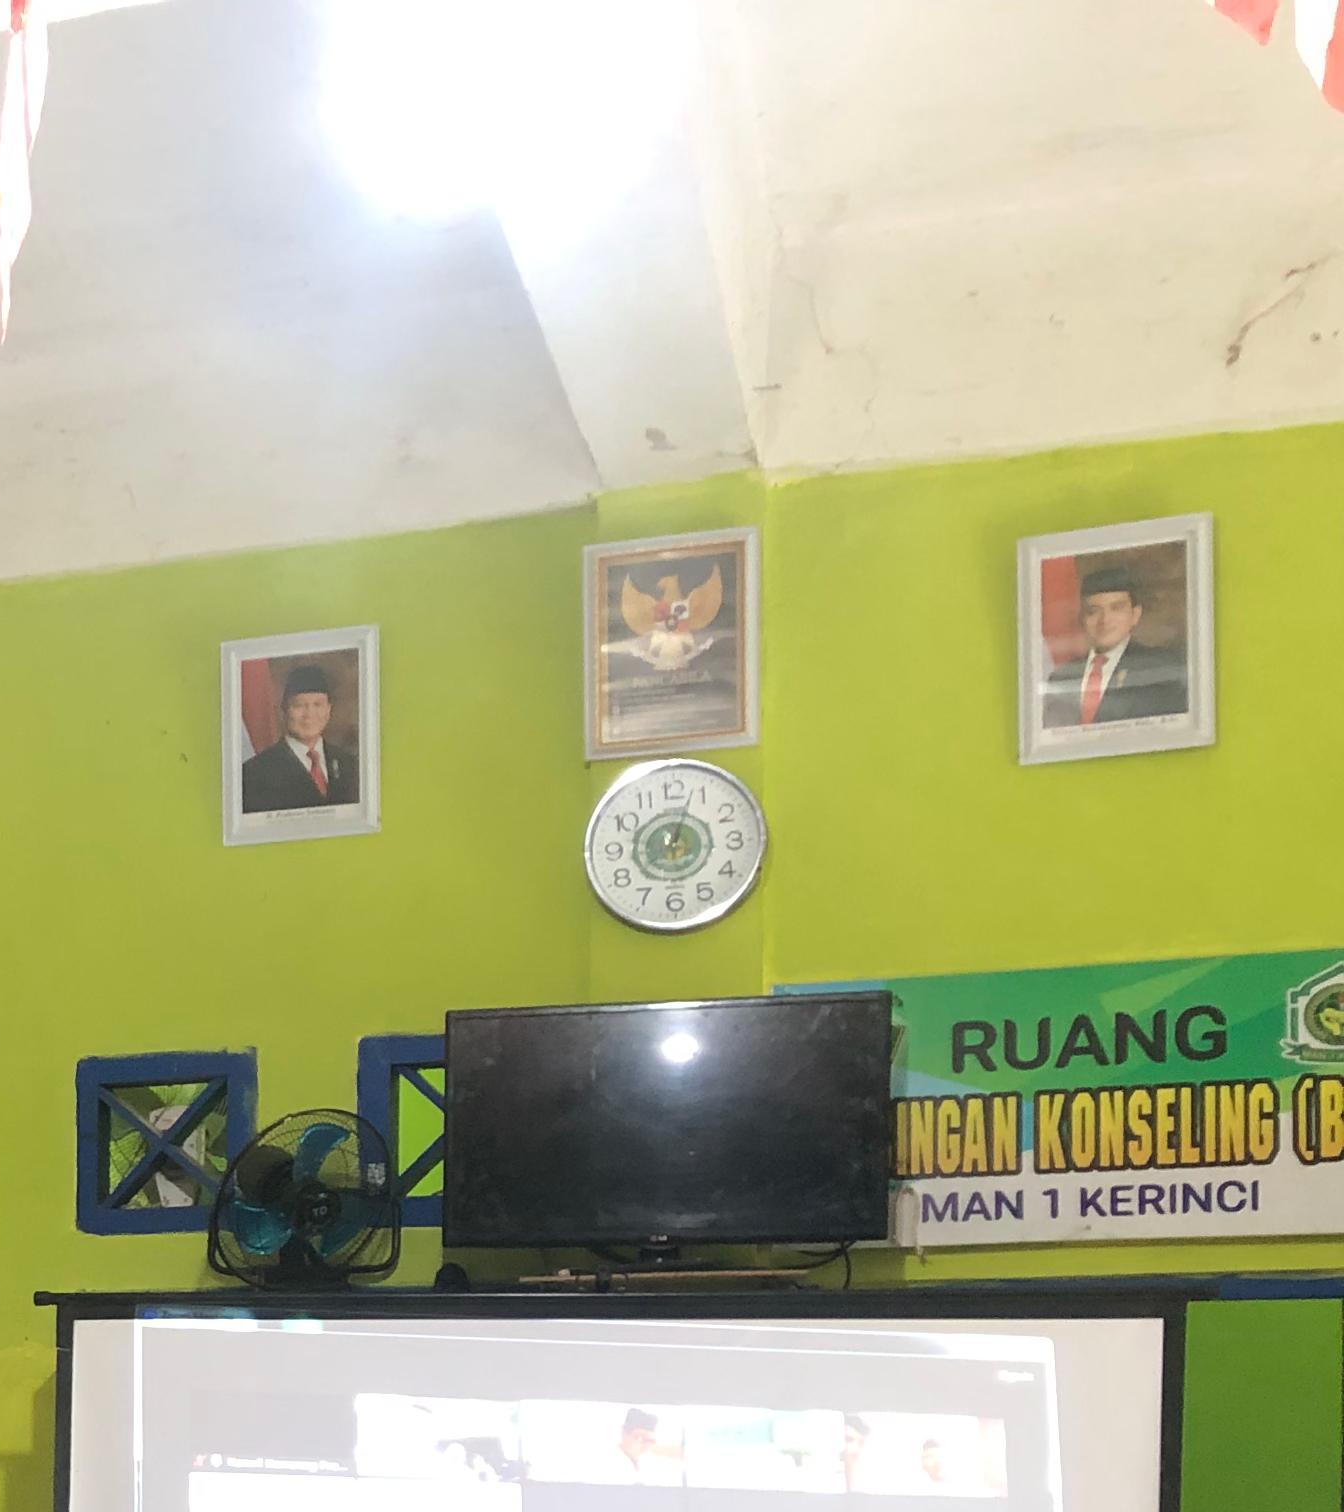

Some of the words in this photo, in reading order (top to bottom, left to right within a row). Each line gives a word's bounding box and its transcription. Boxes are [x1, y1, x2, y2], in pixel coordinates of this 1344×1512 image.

[637, 791, 653, 809] 11
[662, 779, 686, 801] 12
[698, 785, 706, 804] 1
[614, 812, 640, 832] 10
[717, 803, 735, 825] 2
[725, 830, 744, 851] 3
[604, 841, 624, 862] 9
[613, 868, 631, 888] 8
[717, 860, 736, 879] 4
[635, 887, 653, 906] 7
[695, 882, 714, 901] 5
[665, 892, 686, 912] 6
[950, 1004, 1229, 1074] RUANG
[896, 1096, 1021, 1177] INGAN
[1036, 1081, 1277, 1171] KONSELING
[921, 1189, 1024, 1223] MAN
[1045, 1187, 1059, 1219] 1
[1079, 1180, 1261, 1218] KERINCI
